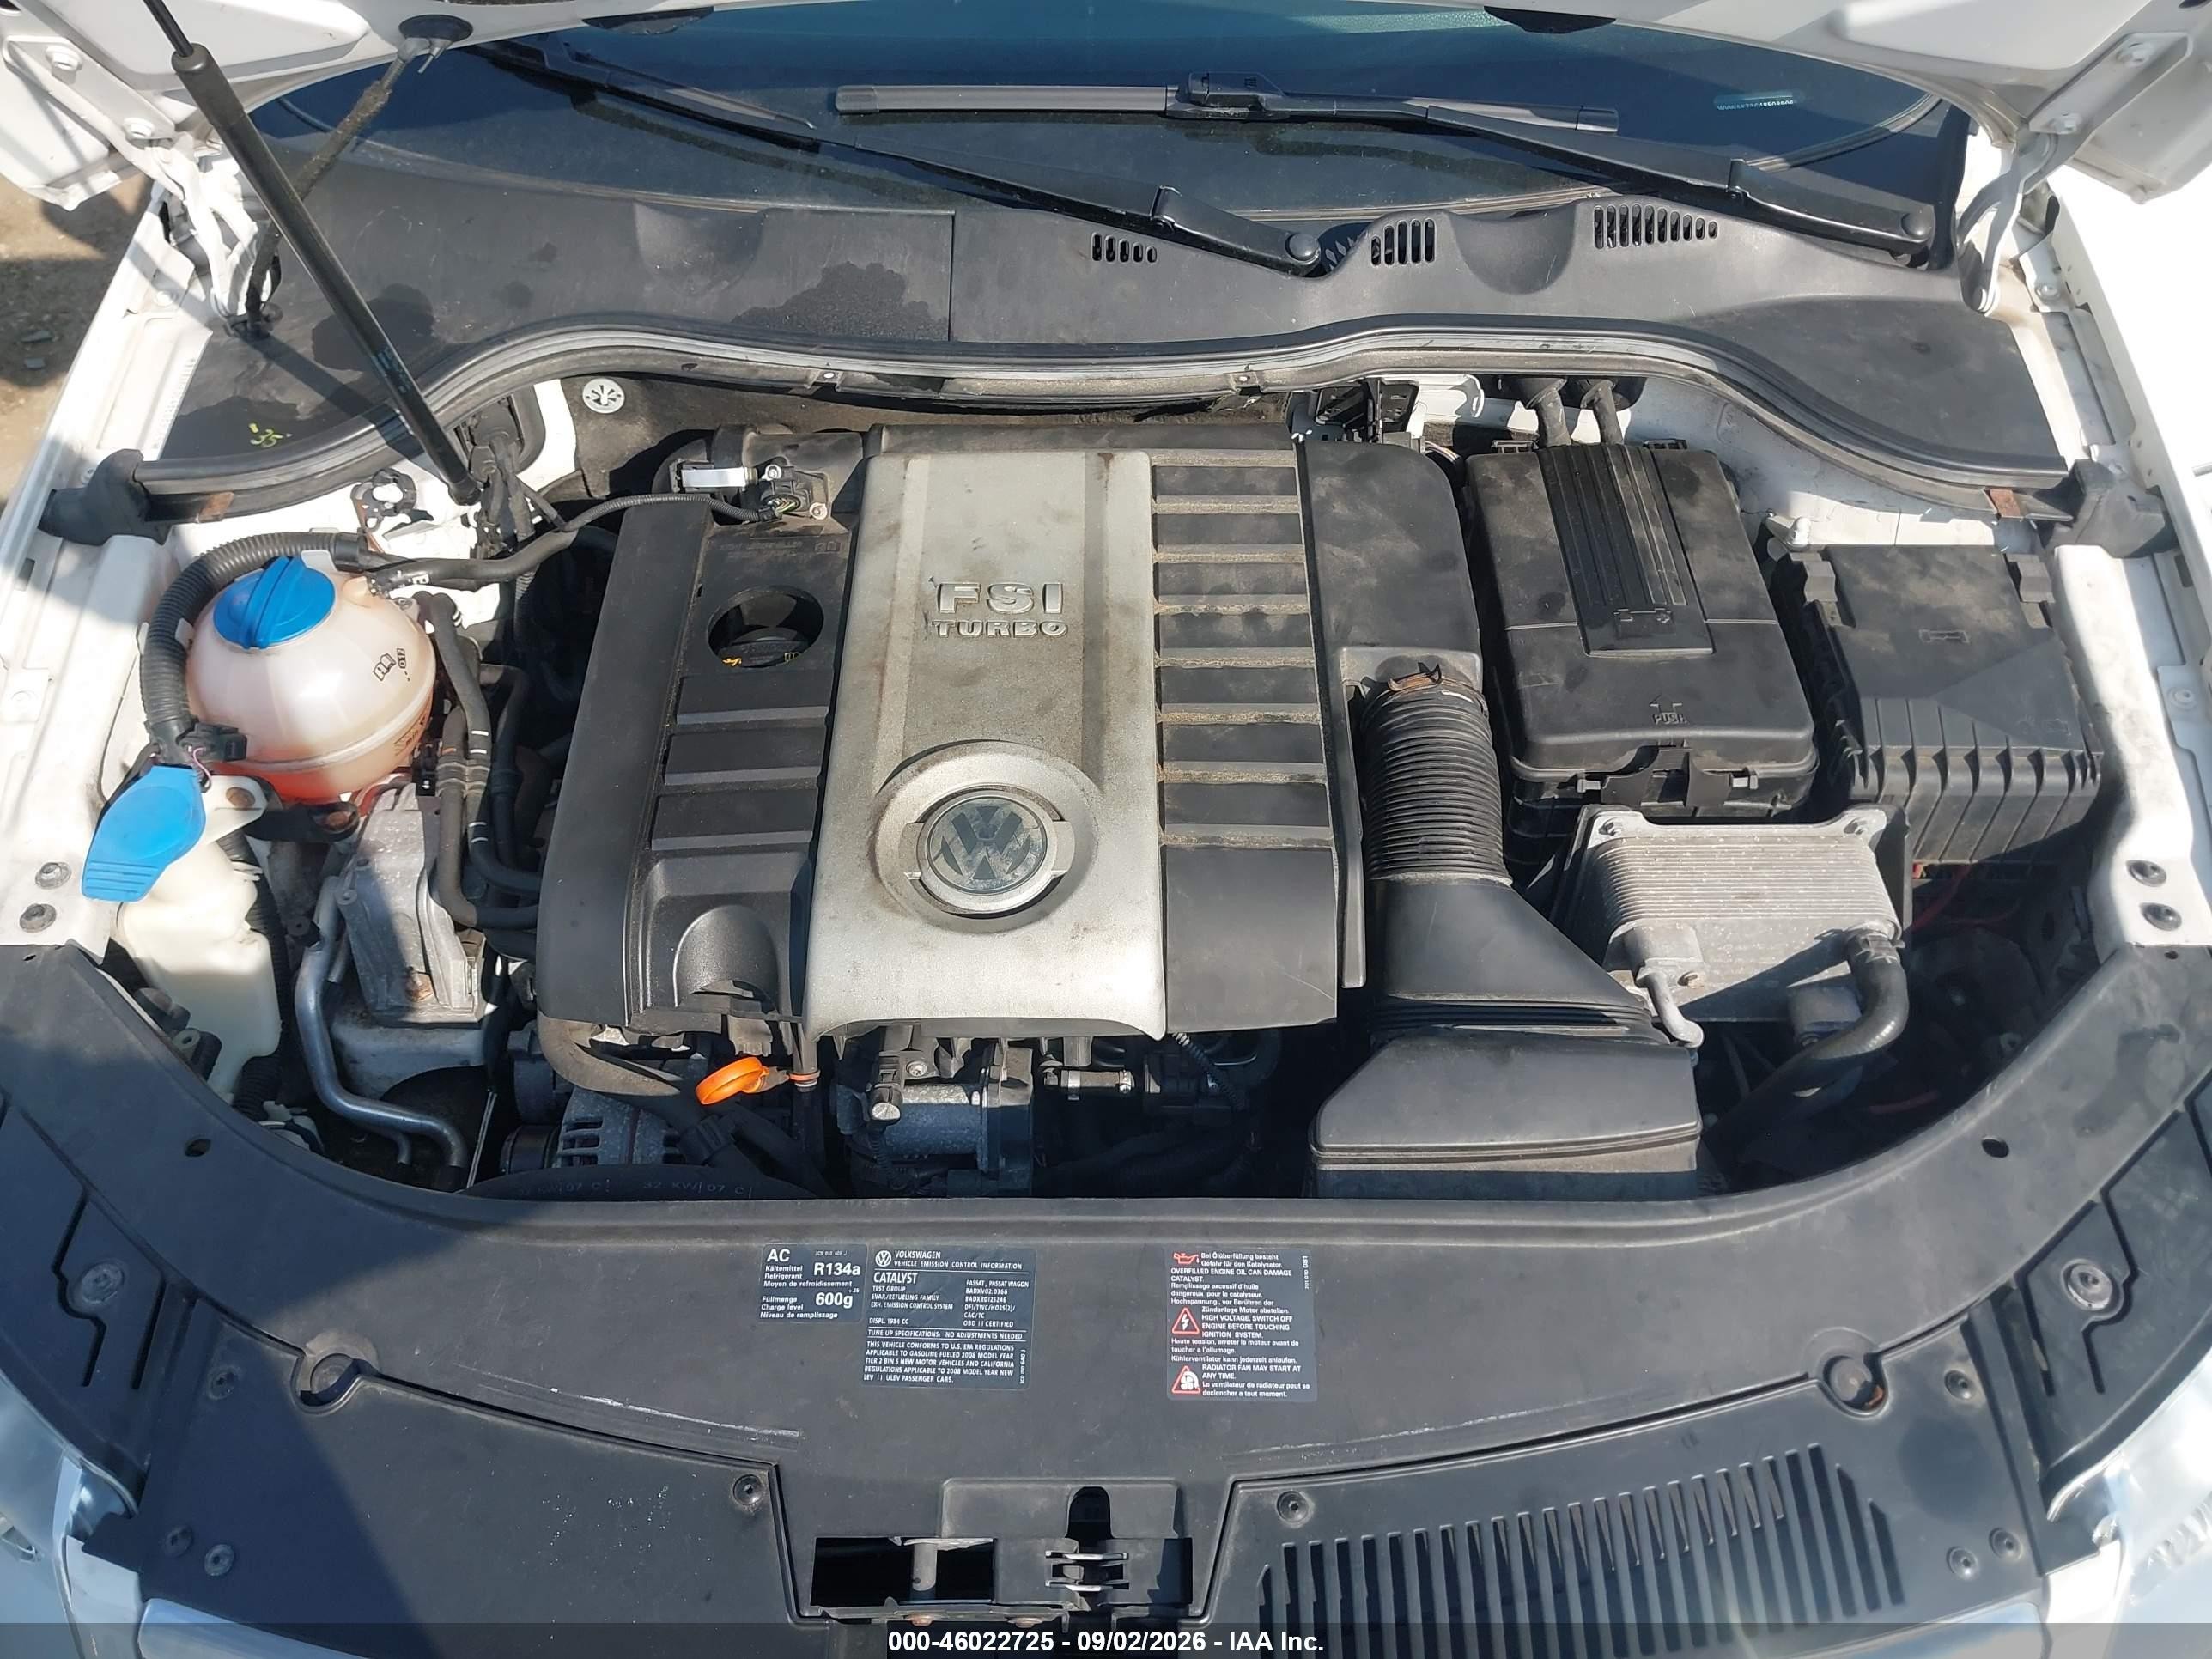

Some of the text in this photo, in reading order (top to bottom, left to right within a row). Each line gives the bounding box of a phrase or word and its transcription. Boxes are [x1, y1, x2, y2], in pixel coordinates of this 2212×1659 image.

[937, 581, 1064, 614] FSI
[931, 619, 1068, 638] TURBO
[767, 1249, 790, 1262] AC
[895, 1250, 941, 1259] VOLKSWAGEN
[814, 1262, 861, 1276] R134a
[874, 1272, 918, 1284] CATALYST
[815, 1292, 853, 1309] 600g
